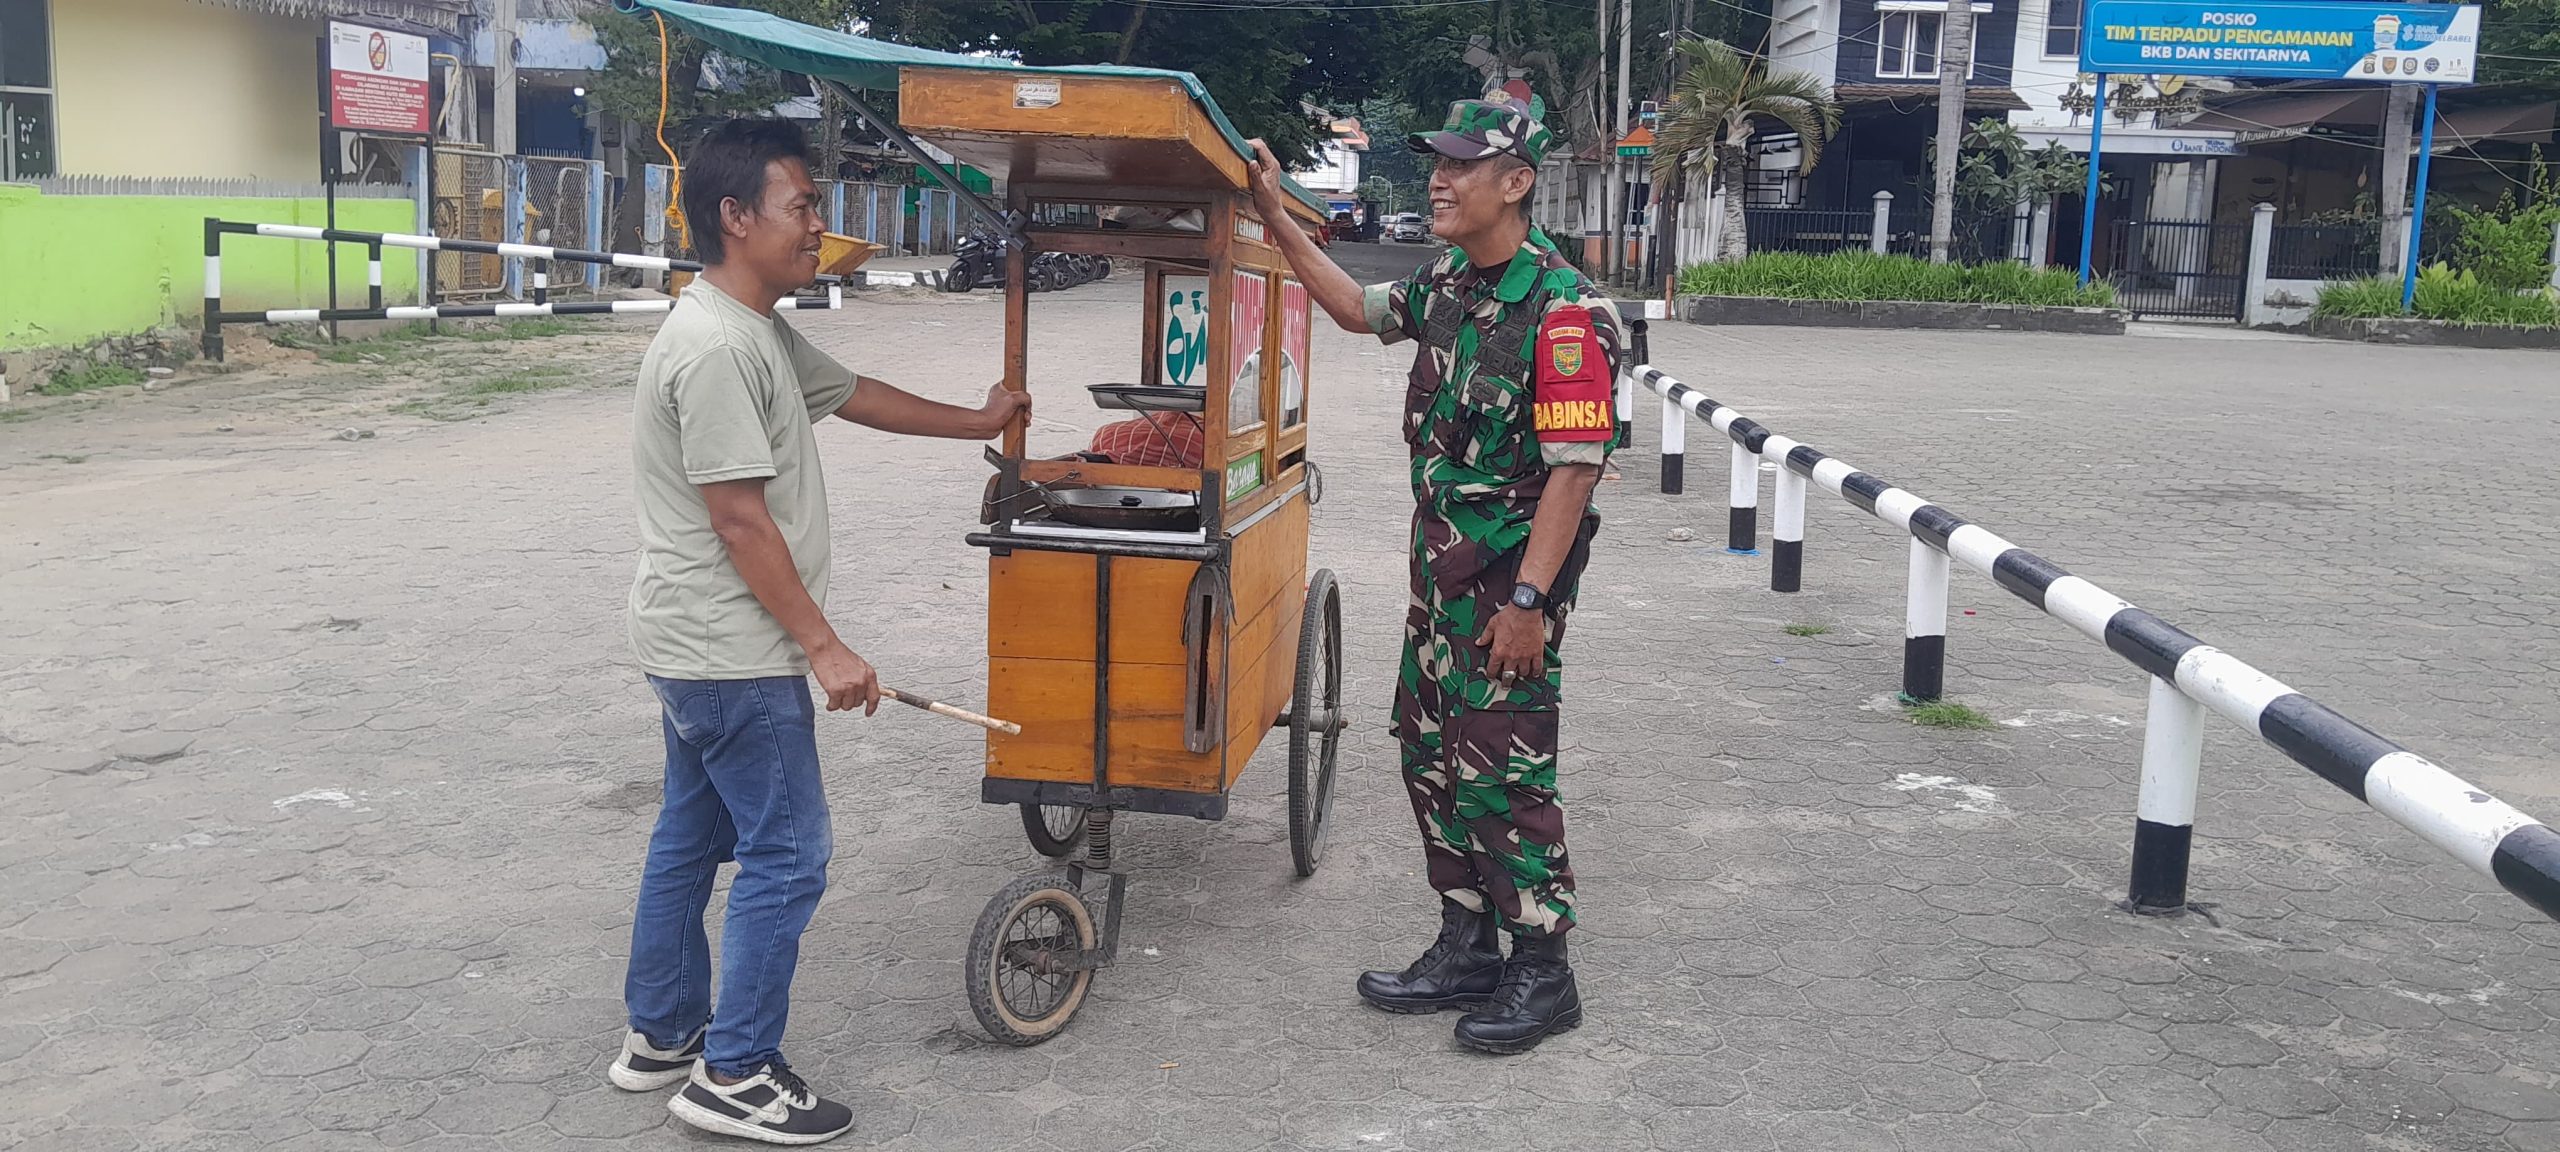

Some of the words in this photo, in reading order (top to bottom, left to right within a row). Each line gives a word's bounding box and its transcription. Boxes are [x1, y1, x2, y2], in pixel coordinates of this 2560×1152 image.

[2202, 11, 2258, 26] POSKO
[2104, 25, 2135, 41] TIM
[2139, 26, 2222, 44] TERPADU
[2224, 28, 2354, 47] PENGAMANAN
[2140, 45, 2172, 59] BKB
[2175, 46, 2210, 60] DAN
[2213, 47, 2312, 63] SEKITARNYA
[2183, 145, 2203, 153] BANK
[1534, 400, 1610, 431] BABINSA
